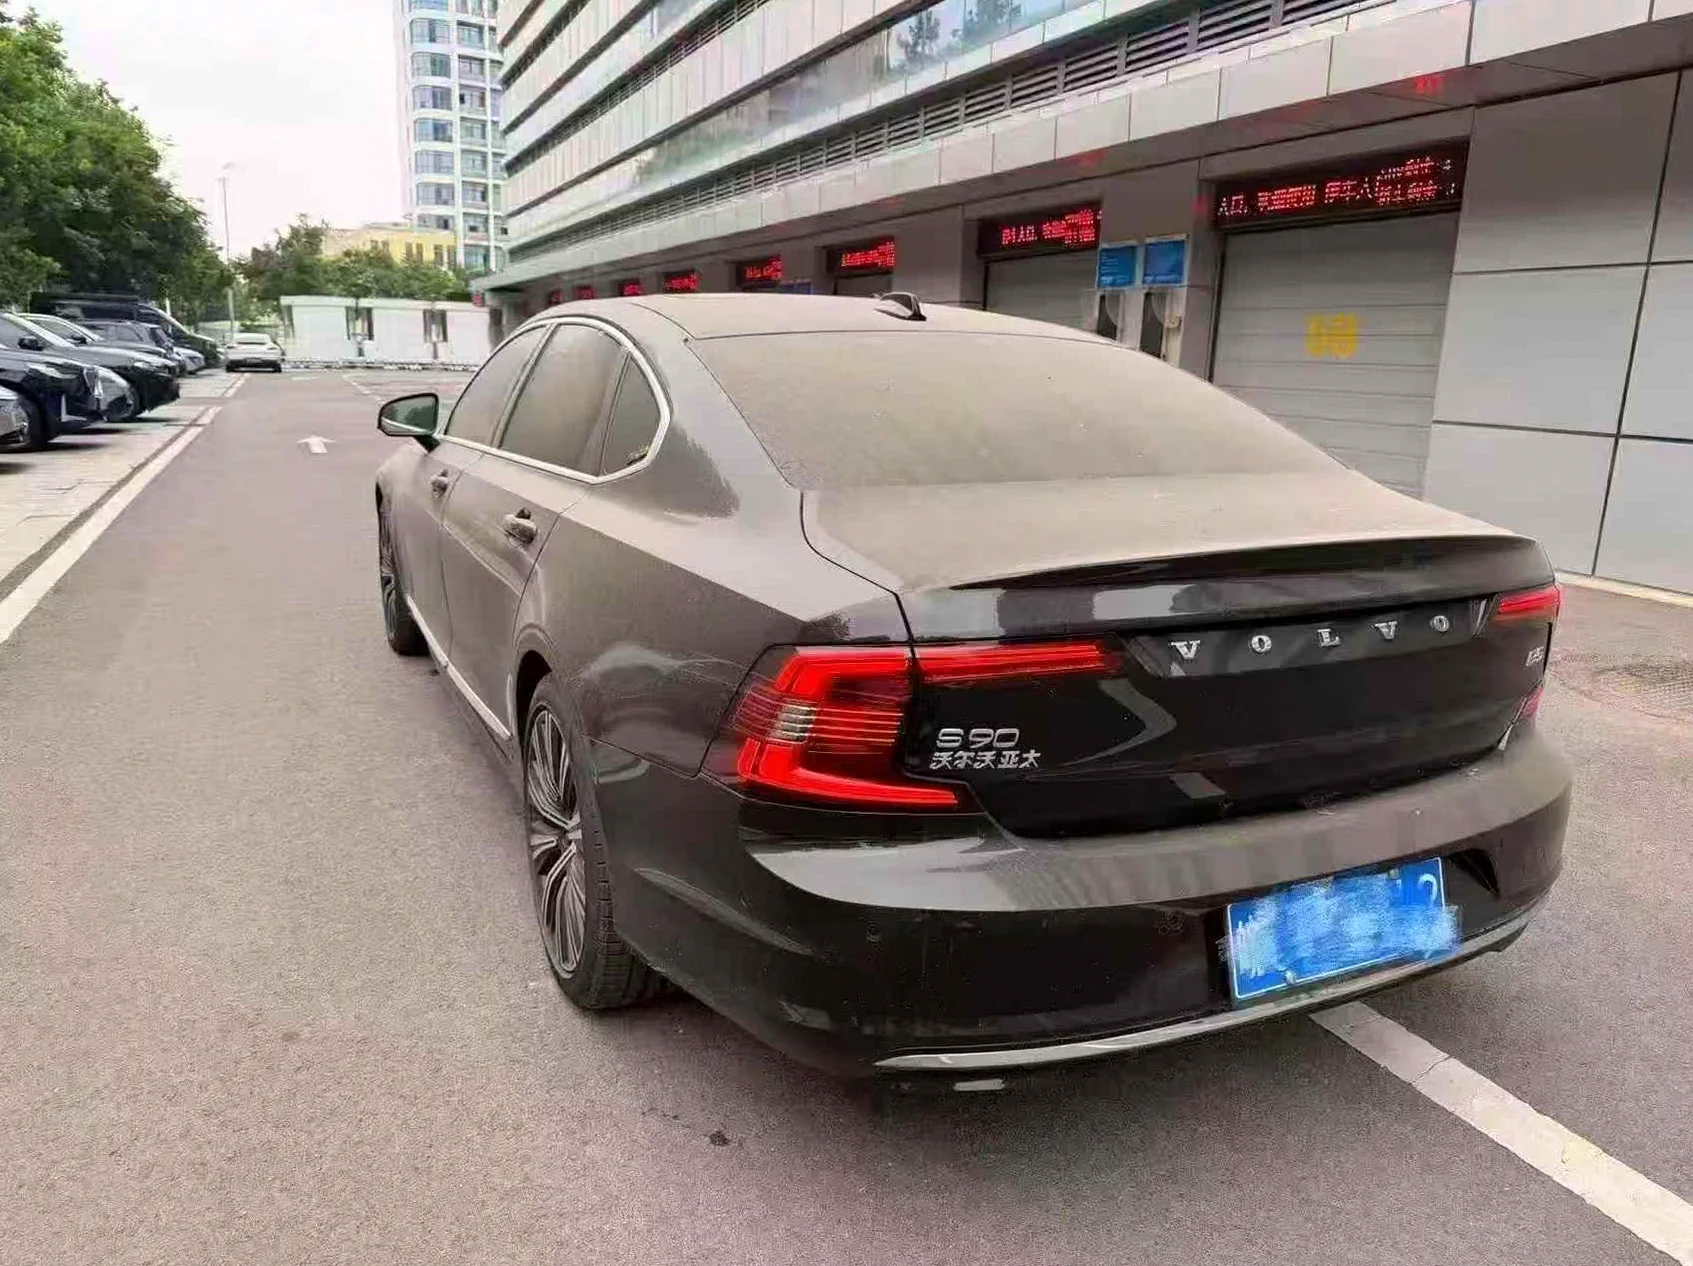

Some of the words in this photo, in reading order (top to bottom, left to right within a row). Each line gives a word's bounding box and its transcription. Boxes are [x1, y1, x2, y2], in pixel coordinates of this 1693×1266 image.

[1170, 614, 1450, 660] VOLVO
[929, 749, 1041, 770] 沃尔沃亚太
